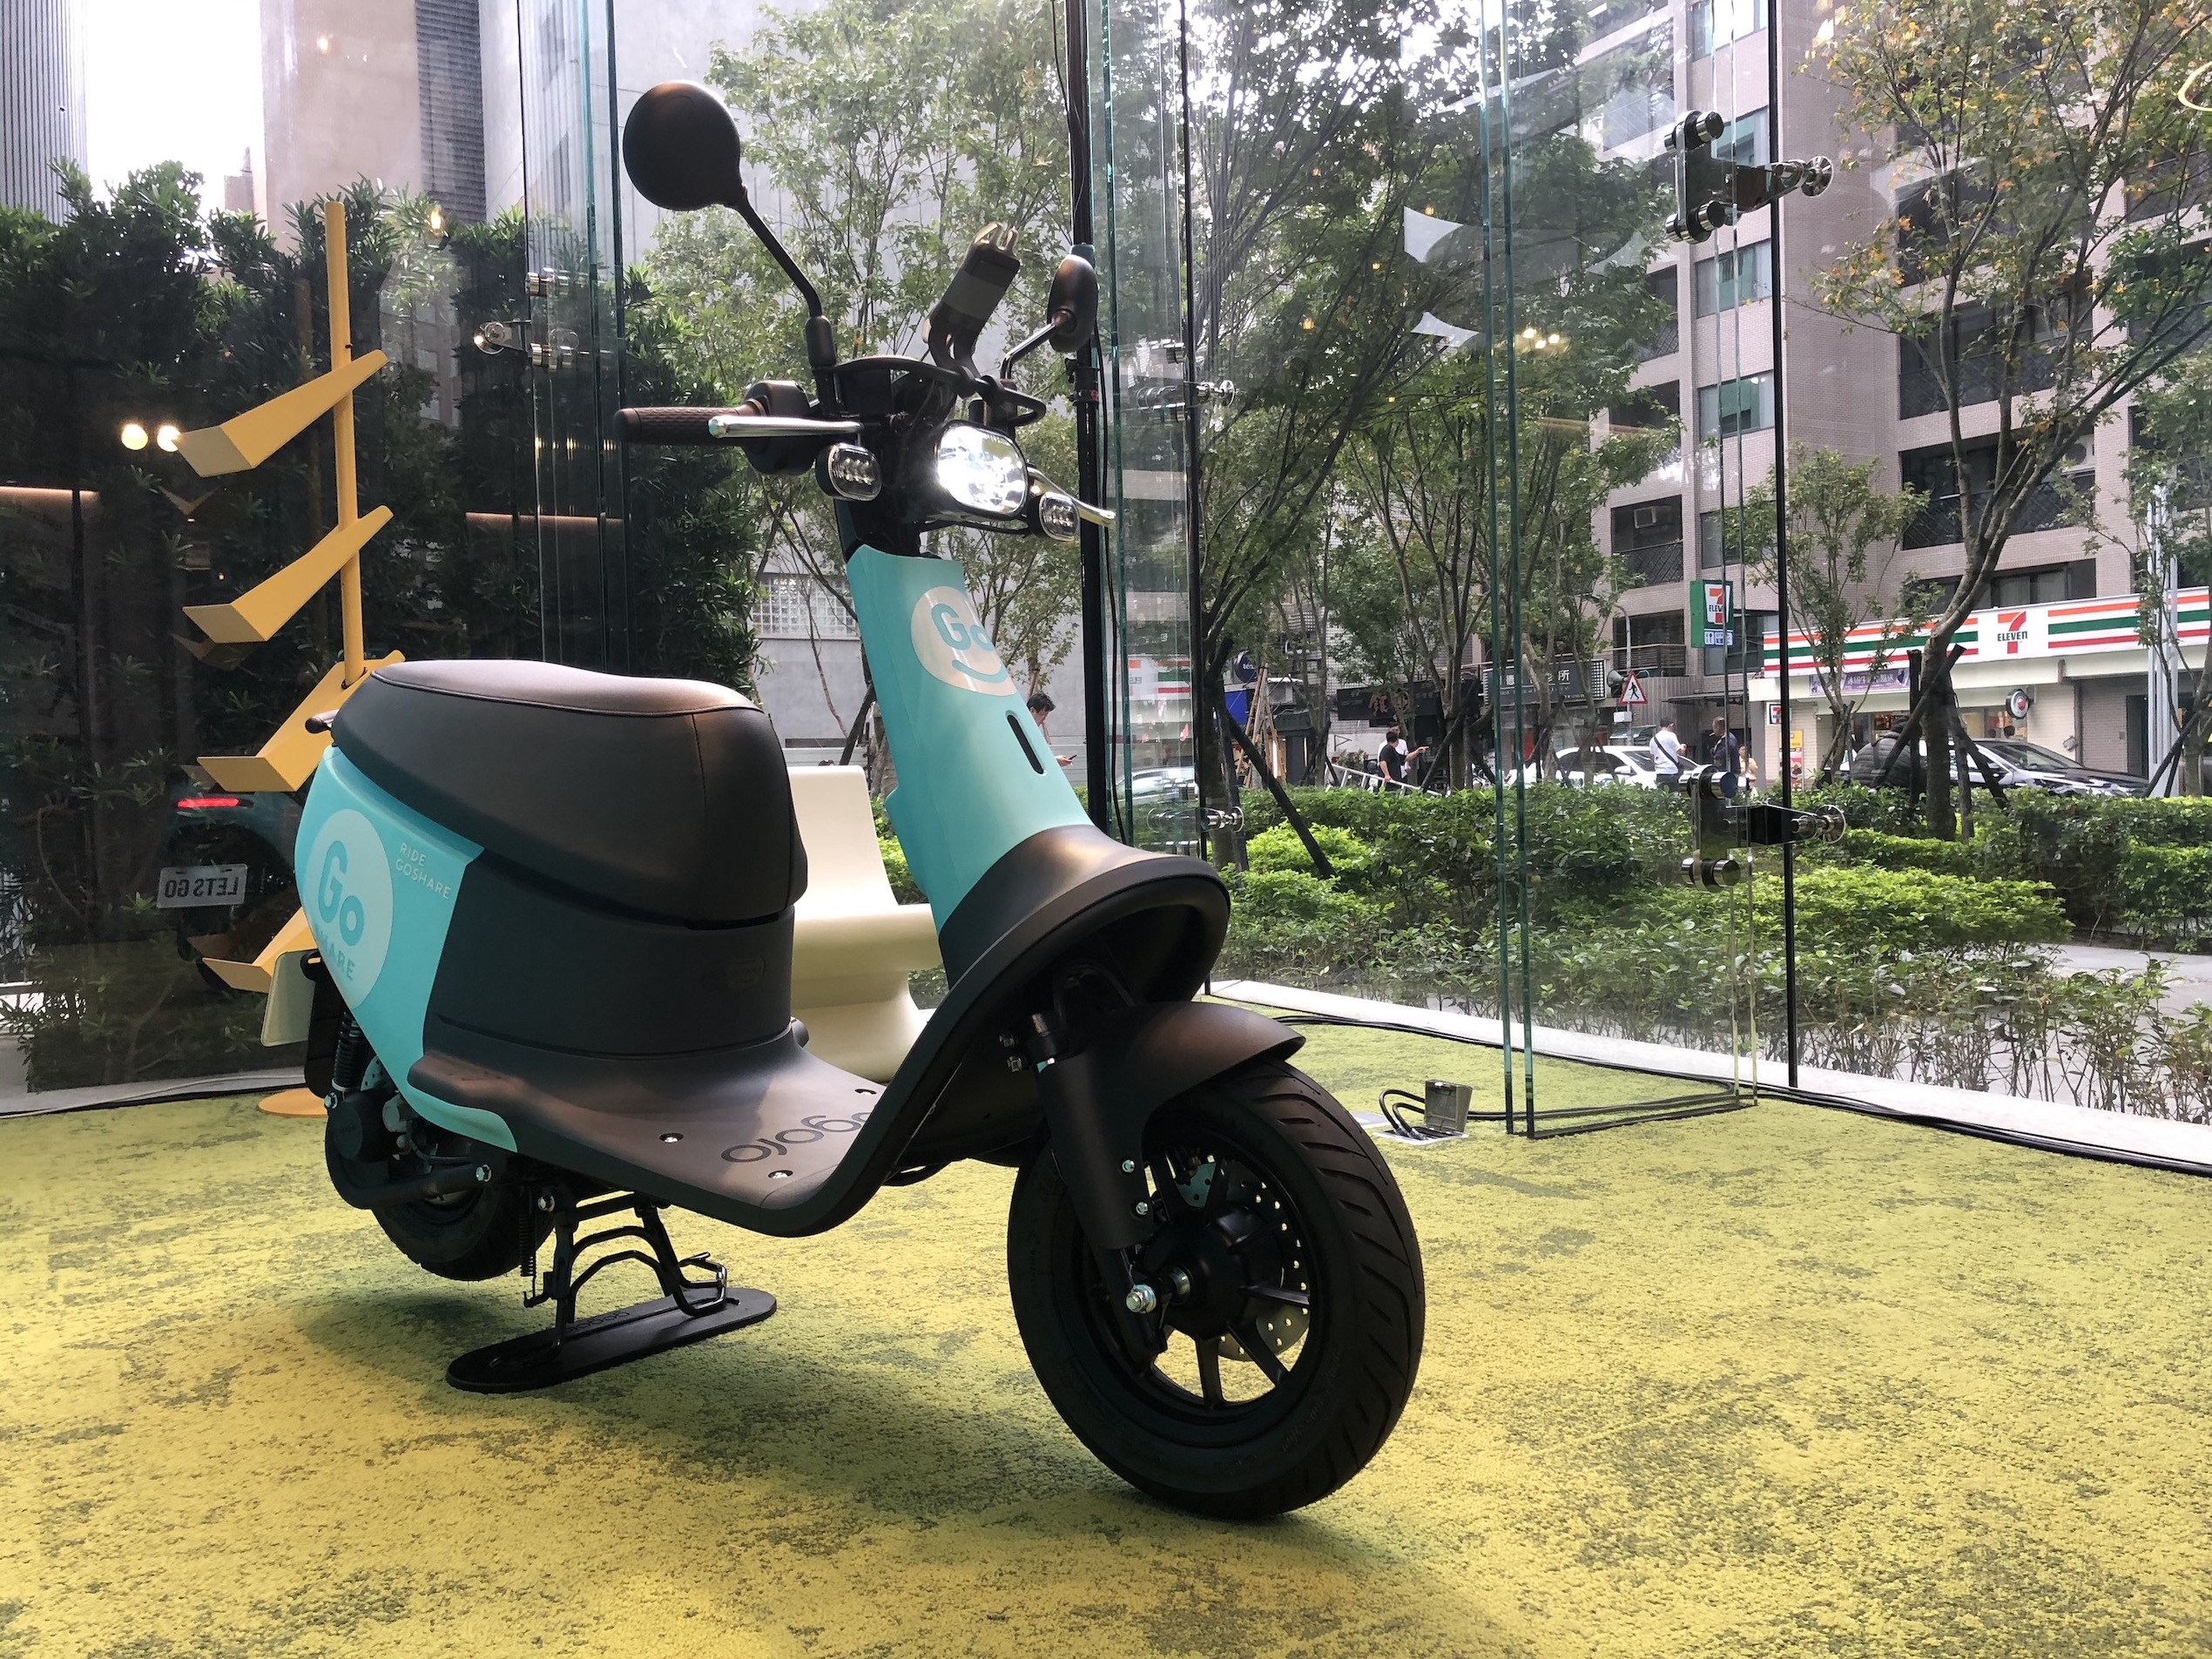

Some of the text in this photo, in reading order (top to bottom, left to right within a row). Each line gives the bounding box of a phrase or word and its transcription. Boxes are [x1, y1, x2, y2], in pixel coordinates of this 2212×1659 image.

[931, 603, 994, 652] Go
[1998, 610, 2027, 654] 7
[400, 842, 426, 867] RIDE
[318, 840, 364, 947] Go
[395, 859, 451, 900] GOSHARE
